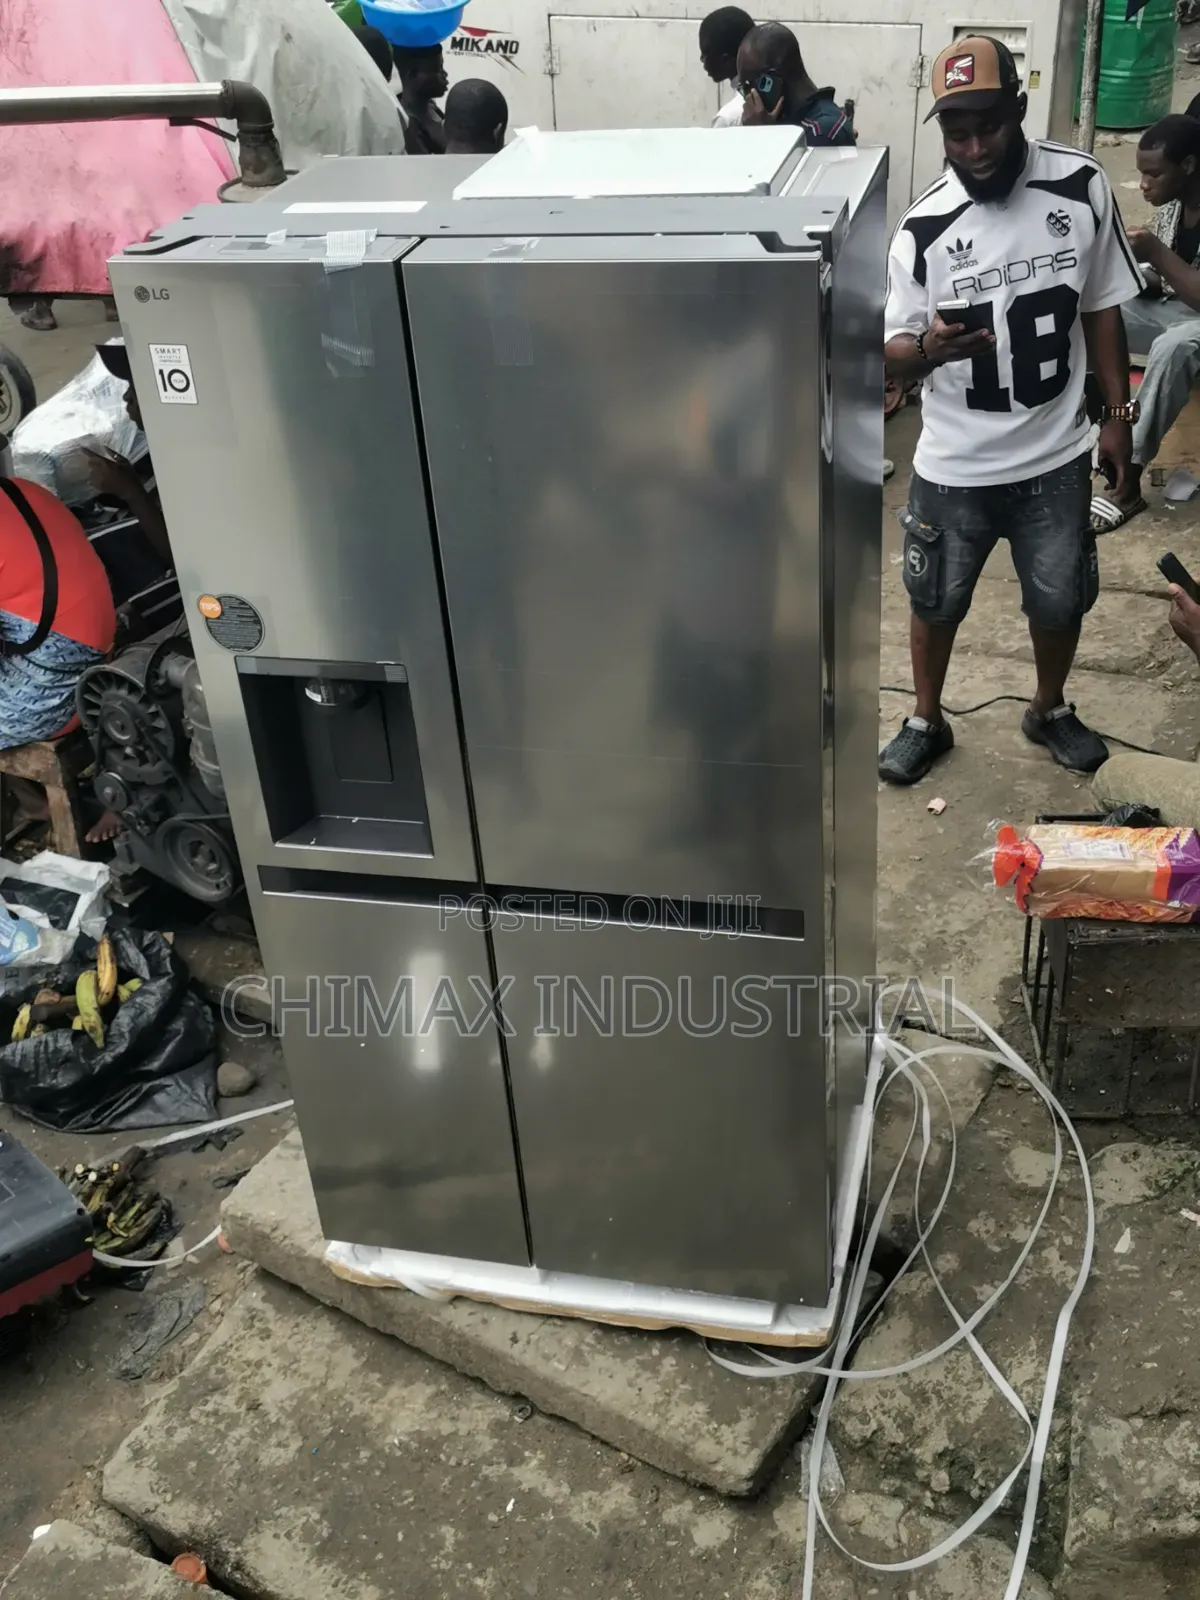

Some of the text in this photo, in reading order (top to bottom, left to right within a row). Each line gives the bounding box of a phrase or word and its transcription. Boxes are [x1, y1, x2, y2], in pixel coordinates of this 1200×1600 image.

[450, 36, 519, 55] MIKANO
[950, 259, 979, 272] adidas
[152, 288, 170, 301] LG
[154, 347, 181, 356] SMART
[965, 284, 1079, 413] 18
[158, 368, 190, 393] 10
